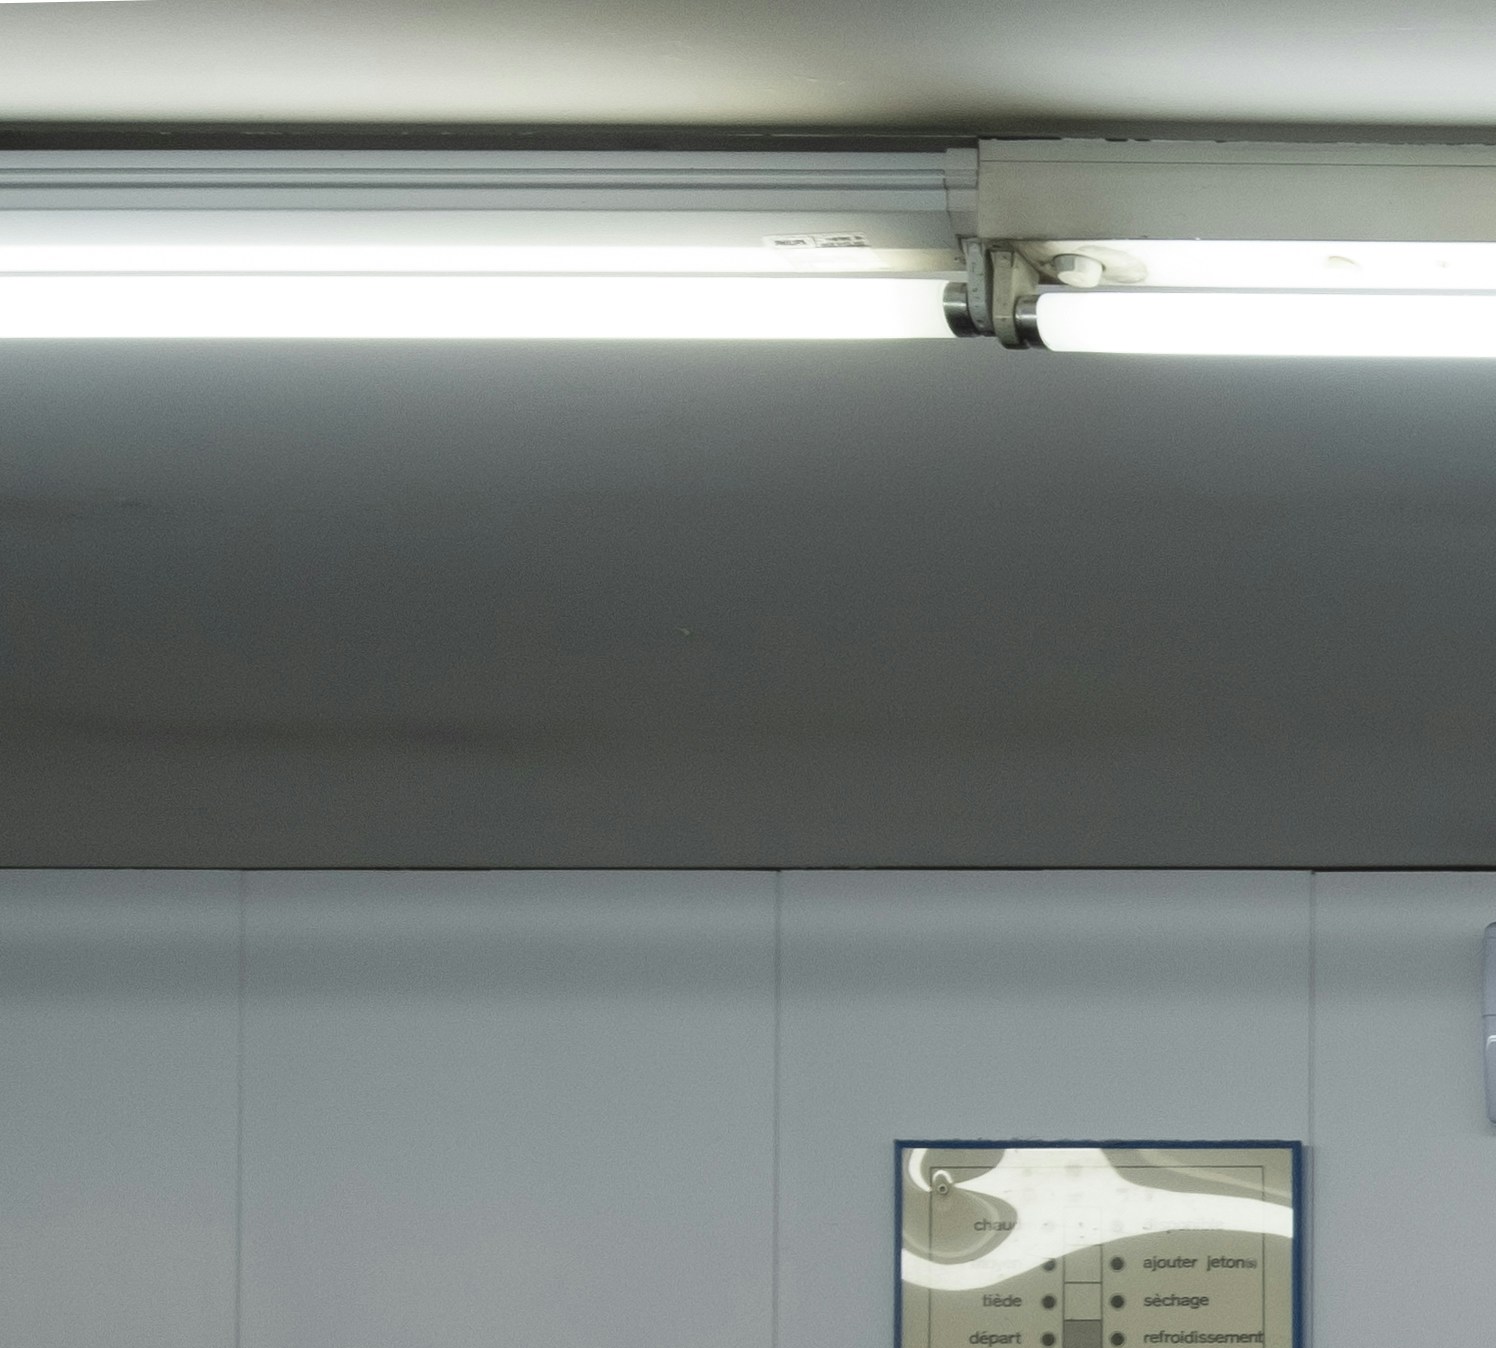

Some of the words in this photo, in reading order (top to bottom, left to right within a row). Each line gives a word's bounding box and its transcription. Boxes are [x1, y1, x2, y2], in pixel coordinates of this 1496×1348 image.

[1143, 1255, 1197, 1271] ajouter
[983, 1294, 1022, 1307] tiède
[969, 1331, 1022, 1347] départ
[1143, 1331, 1264, 1345] refroidissement
